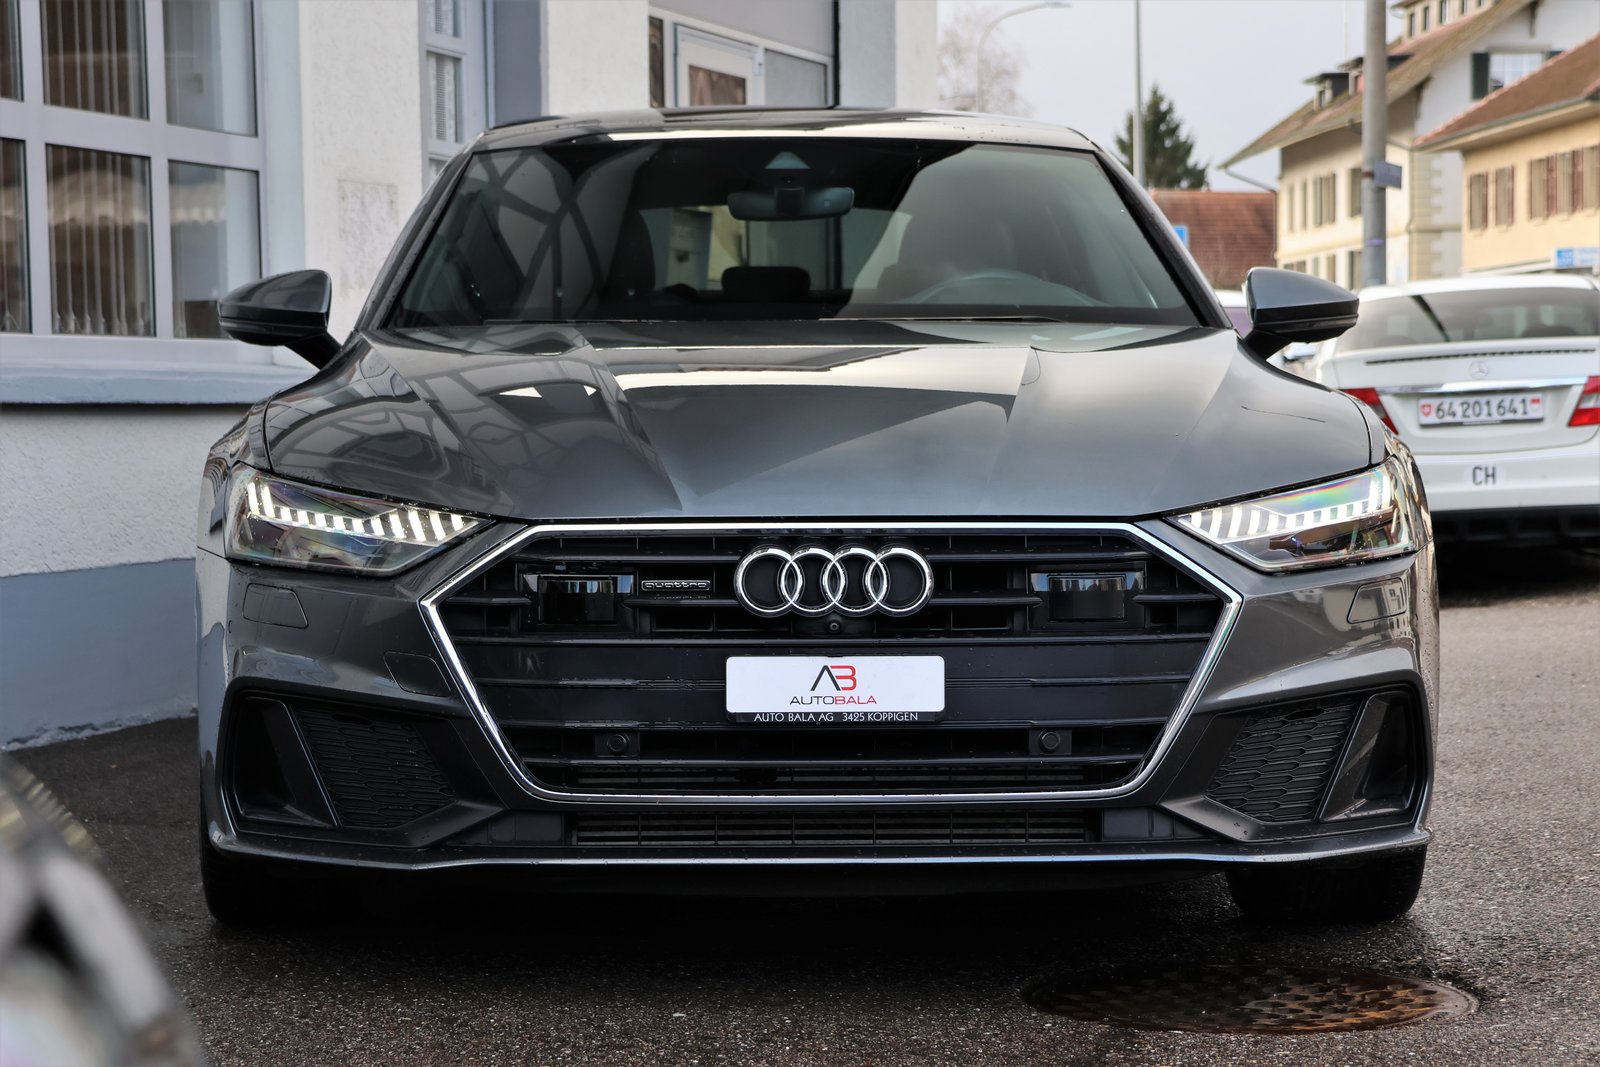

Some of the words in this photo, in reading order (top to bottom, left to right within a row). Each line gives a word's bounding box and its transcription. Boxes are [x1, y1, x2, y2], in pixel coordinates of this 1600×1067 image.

[1472, 466, 1497, 485] CH
[754, 713, 784, 722] AUTO
[788, 713, 815, 722] BALA
[818, 713, 834, 722] AG
[842, 712, 865, 721] 3425
[867, 712, 918, 721] KOPPIGEN
